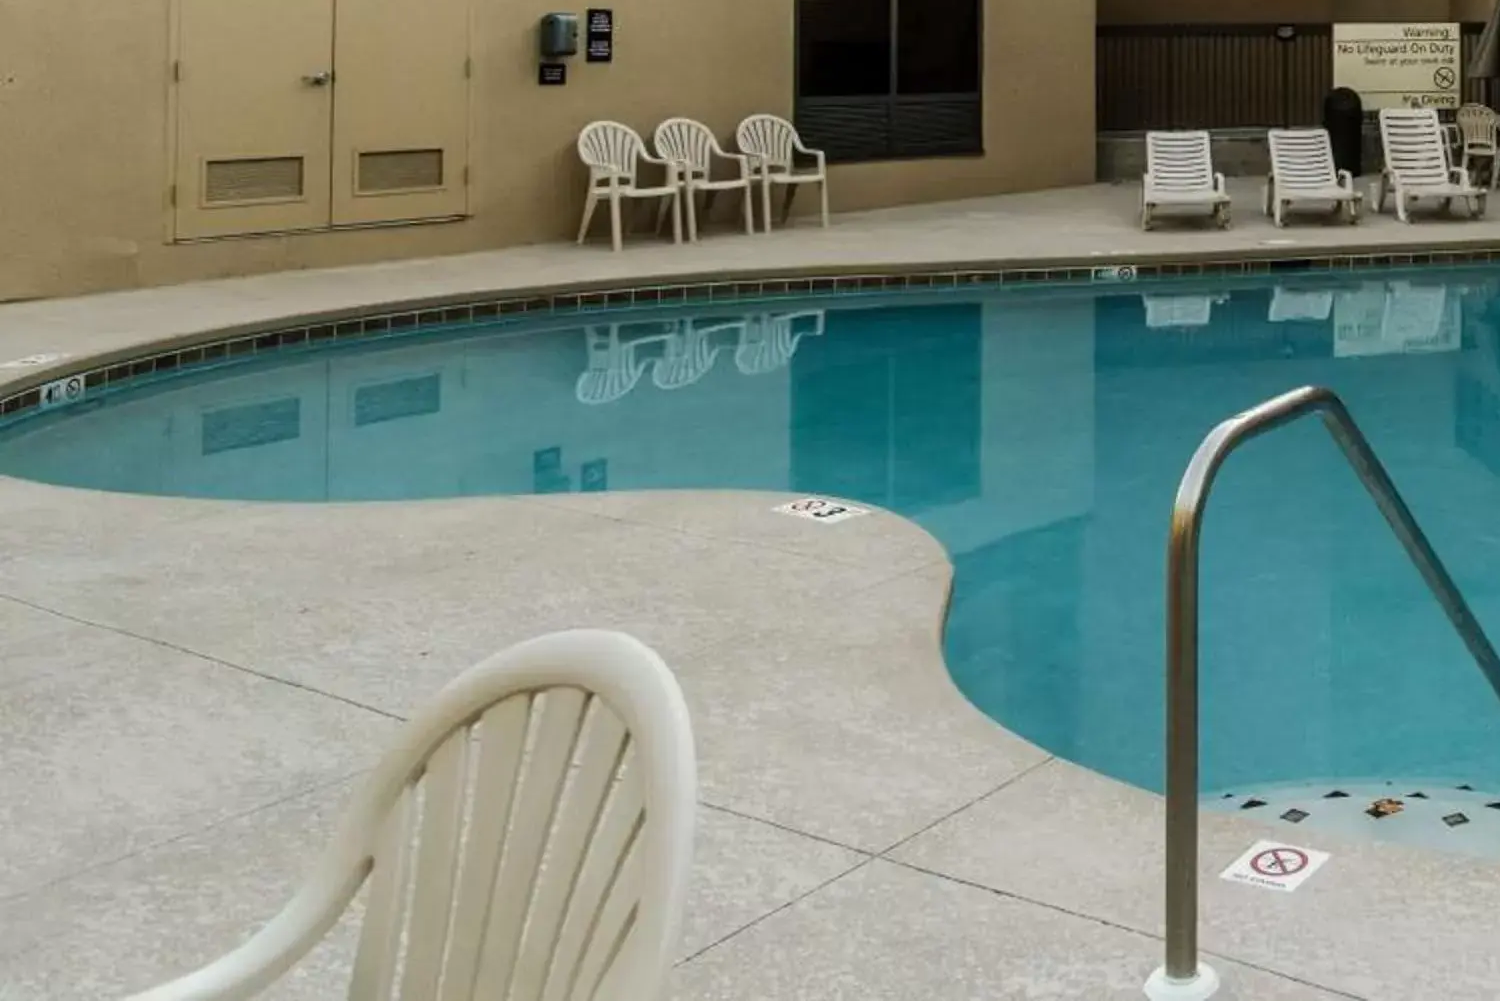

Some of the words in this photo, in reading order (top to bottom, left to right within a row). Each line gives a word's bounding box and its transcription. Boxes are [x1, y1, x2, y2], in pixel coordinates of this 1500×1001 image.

[1337, 44, 1354, 54] No
[1357, 43, 1407, 55] Lifeguard
[1410, 42, 1426, 54] On
[1429, 43, 1454, 55] Duty
[1421, 95, 1456, 107] Diving
